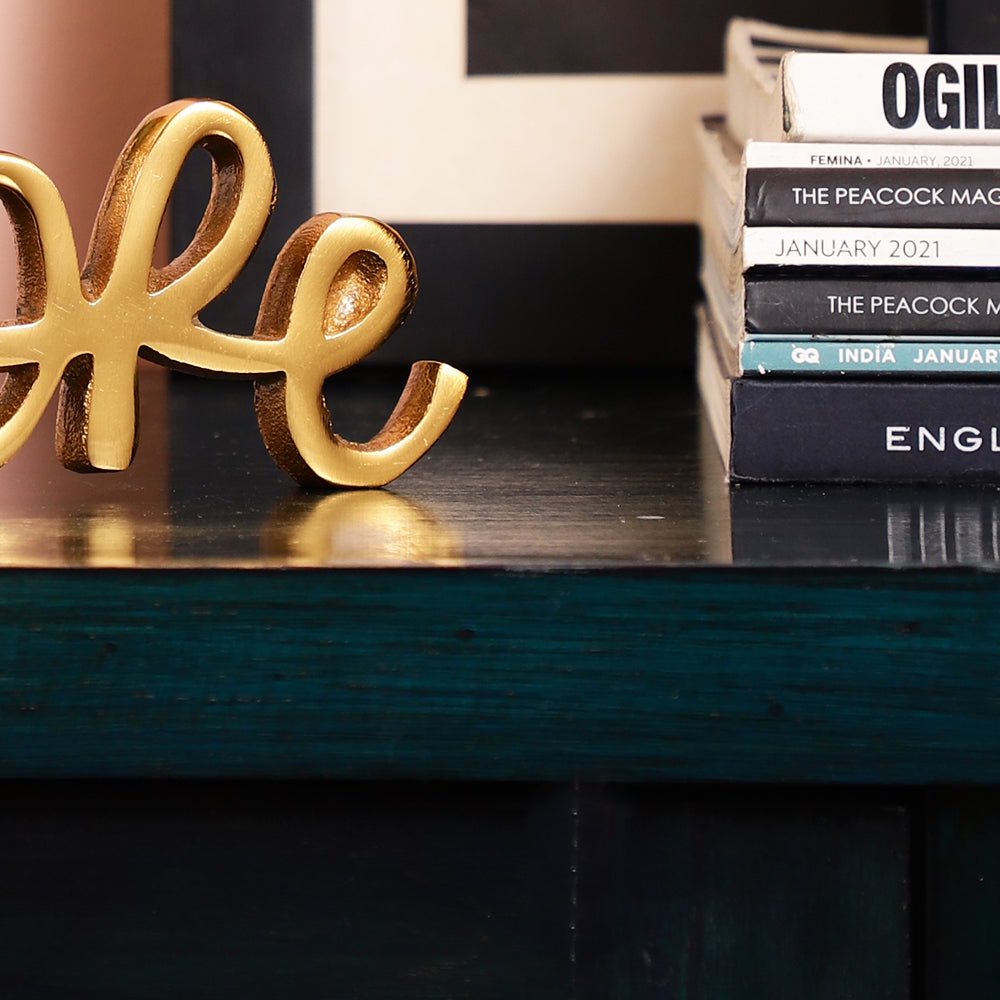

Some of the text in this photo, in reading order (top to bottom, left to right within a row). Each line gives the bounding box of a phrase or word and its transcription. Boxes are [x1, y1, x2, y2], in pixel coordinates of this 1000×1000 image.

[882, 62, 1000, 129] OGIL
[810, 155, 973, 168] FEMINA JANUARY, 2021
[792, 187, 1000, 205] THE PEACOCK MAG
[775, 239, 940, 258] JANUARY 2021
[827, 295, 864, 313] THE
[870, 296, 980, 315] PEACOCK
[791, 346, 1000, 364] GQ INDIA JANUAR
[886, 425, 1000, 452] ENGL
